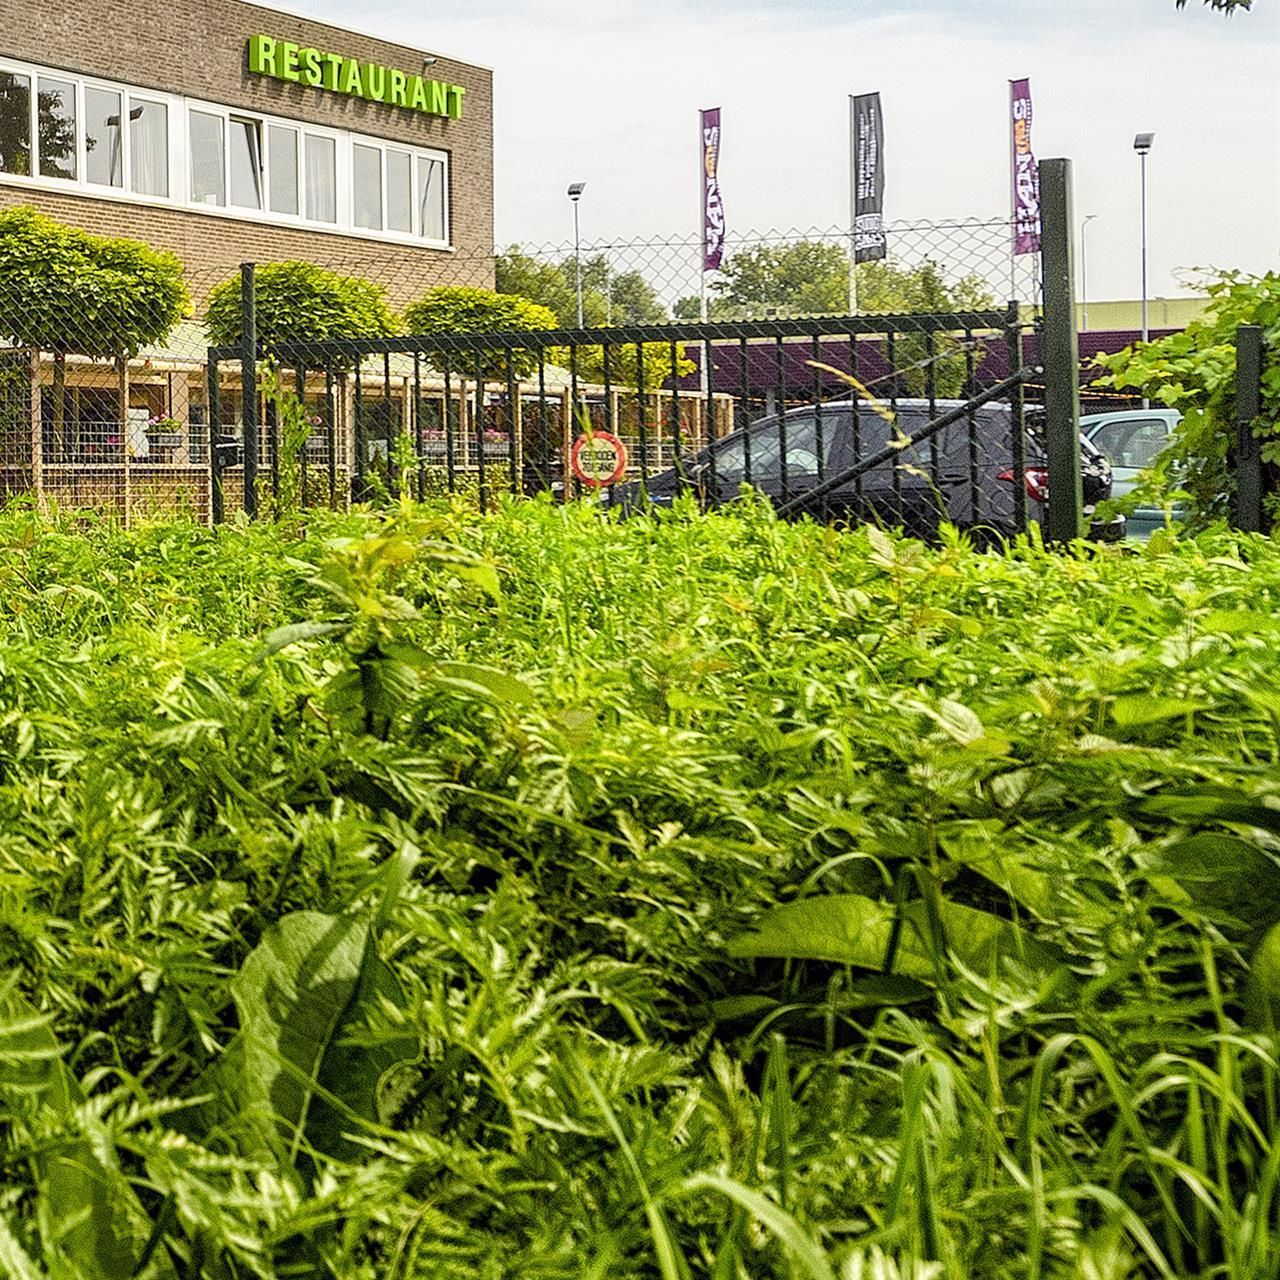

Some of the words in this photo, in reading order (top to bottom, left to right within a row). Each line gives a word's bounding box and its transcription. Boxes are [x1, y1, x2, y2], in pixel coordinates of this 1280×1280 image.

[249, 35, 465, 119] RESTAURANT
[580, 450, 616, 461] VEBODEN
[582, 462, 615, 472] TOGANG
